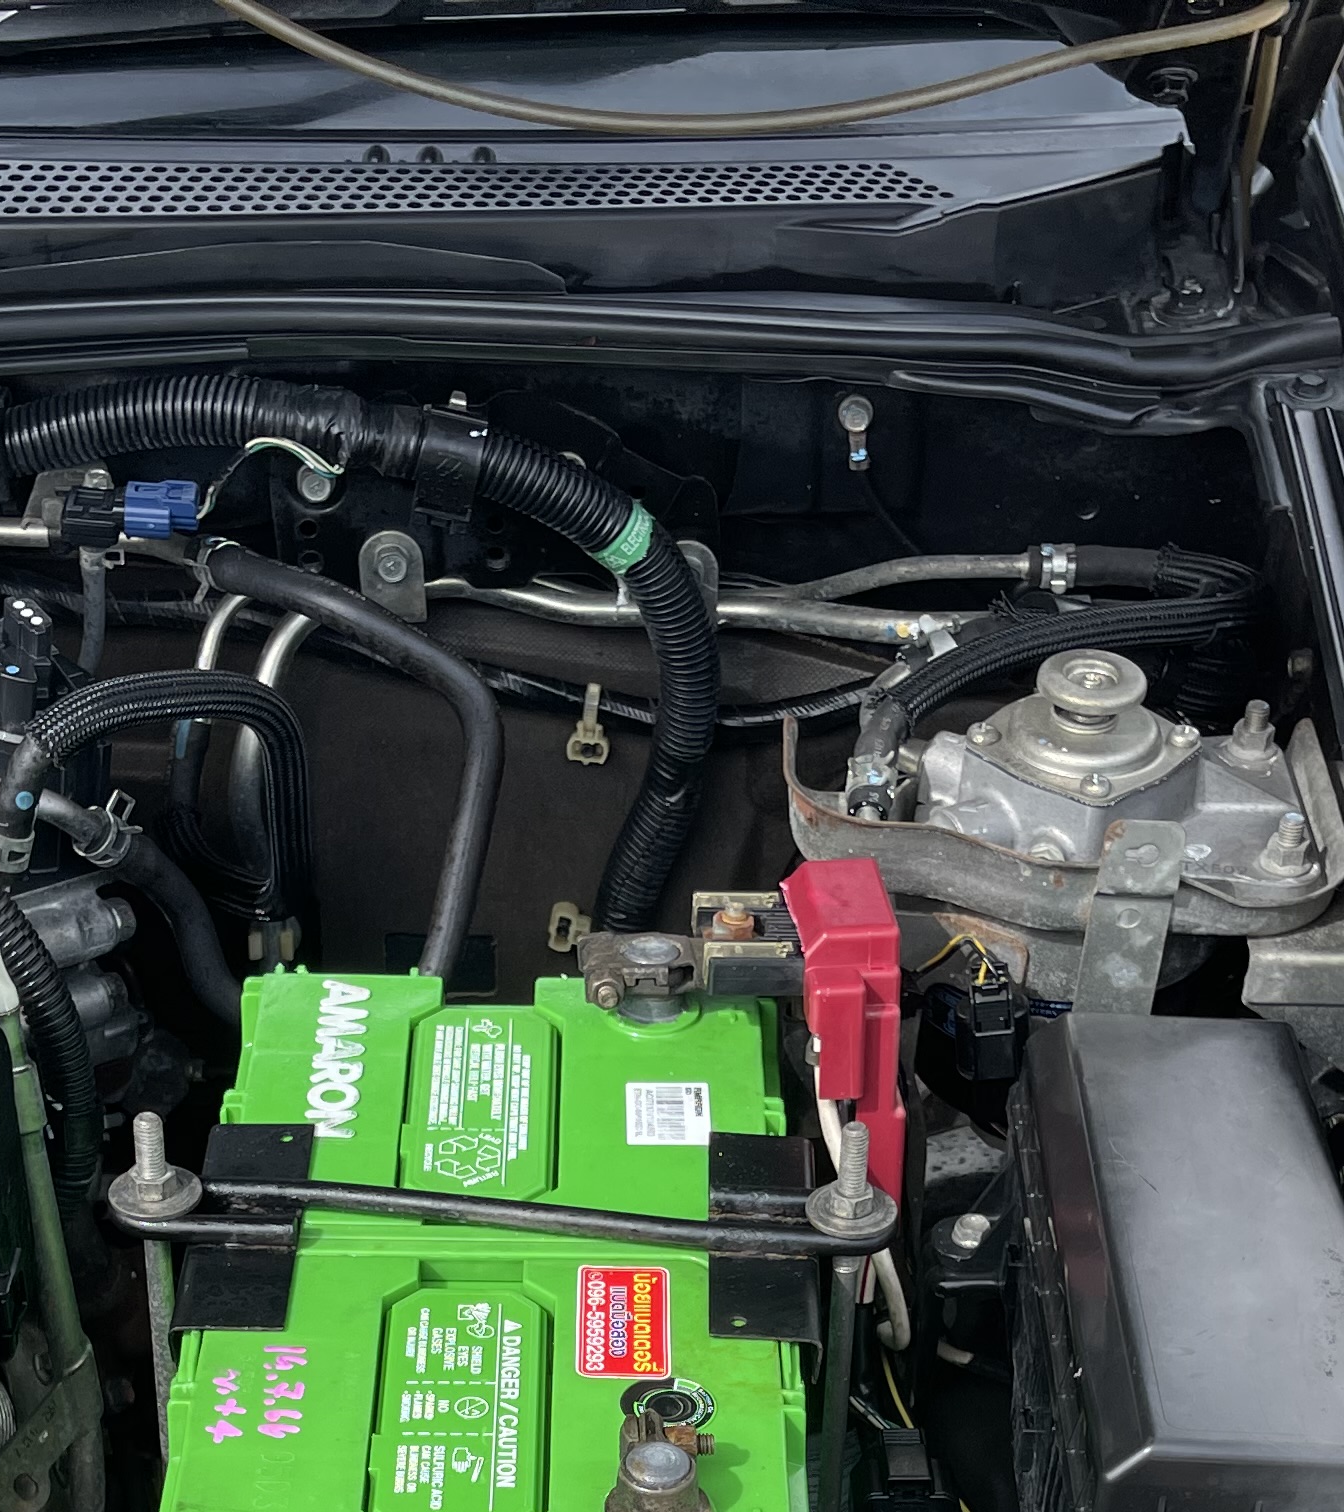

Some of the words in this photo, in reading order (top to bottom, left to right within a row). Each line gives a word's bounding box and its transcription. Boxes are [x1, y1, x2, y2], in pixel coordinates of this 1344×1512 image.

[304, 979, 371, 1138] AMARON
[431, 1327, 443, 1354] GASES
[586, 1281, 606, 1371] 096-5959293
[443, 1327, 457, 1371] EXPLOSIVE
[457, 1345, 469, 1367] EYES
[470, 1346, 483, 1374] SHIELD
[500, 1336, 522, 1400] DANGER
[438, 1400, 450, 1413] NO
[431, 1445, 446, 1488] SULFURIC
[496, 1414, 519, 1488] CAUTION
[429, 1489, 444, 1510] ACID
